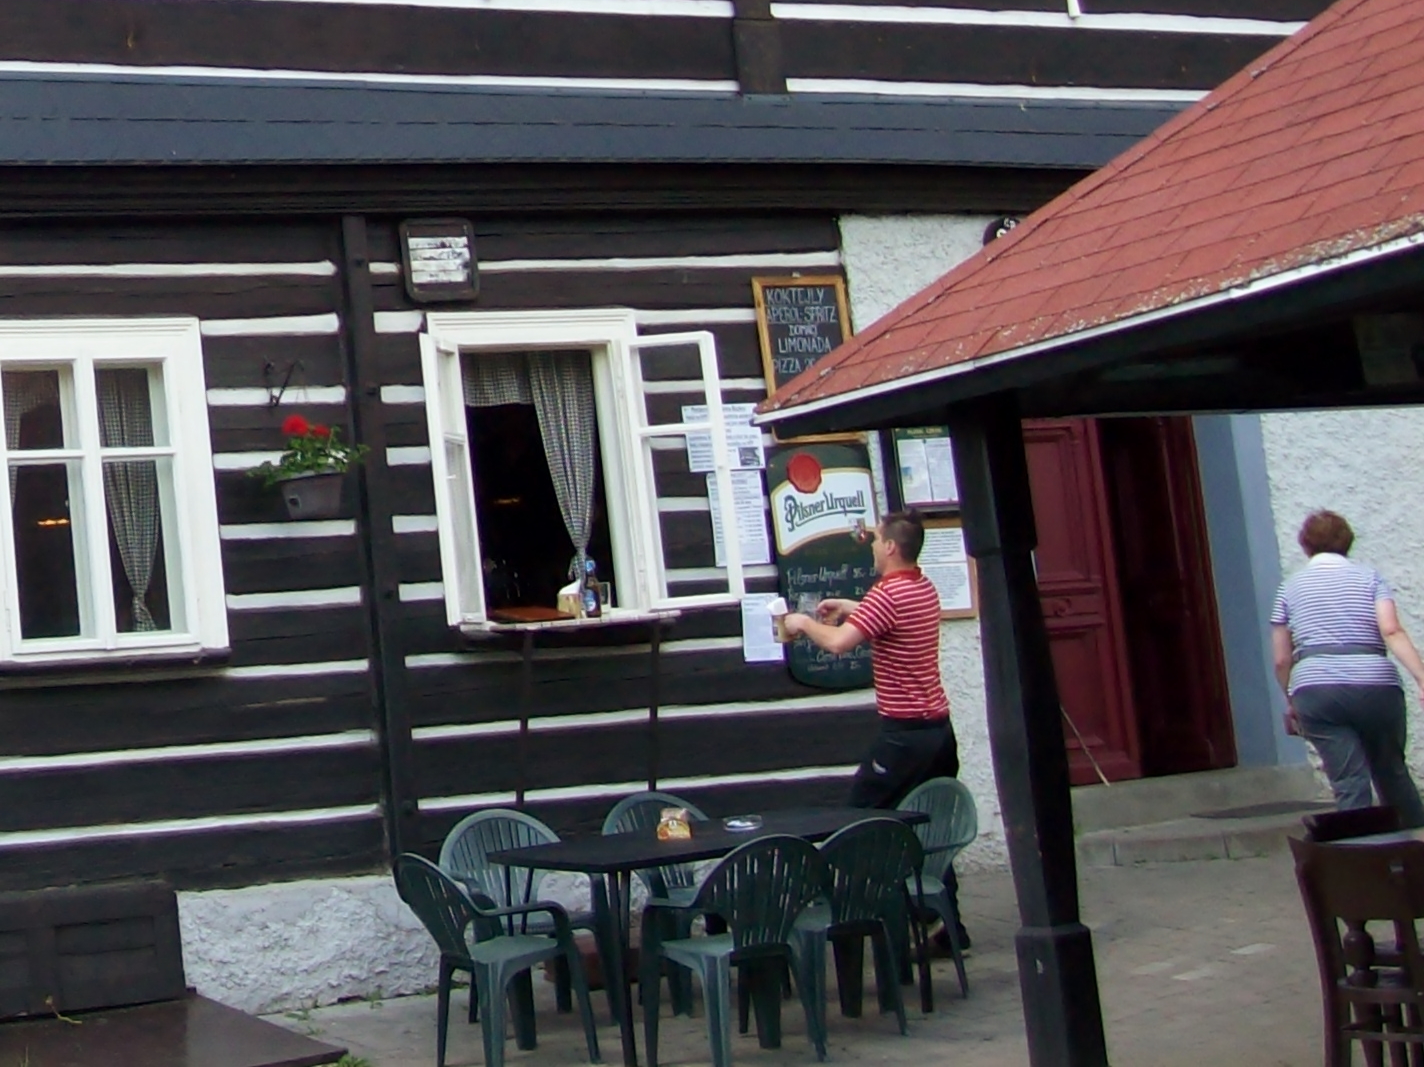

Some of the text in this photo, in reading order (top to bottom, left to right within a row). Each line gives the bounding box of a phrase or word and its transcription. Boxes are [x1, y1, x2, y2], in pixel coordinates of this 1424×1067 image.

[766, 287, 824, 305] KOKTEJLY
[783, 490, 866, 533] Pilsner Urquell
